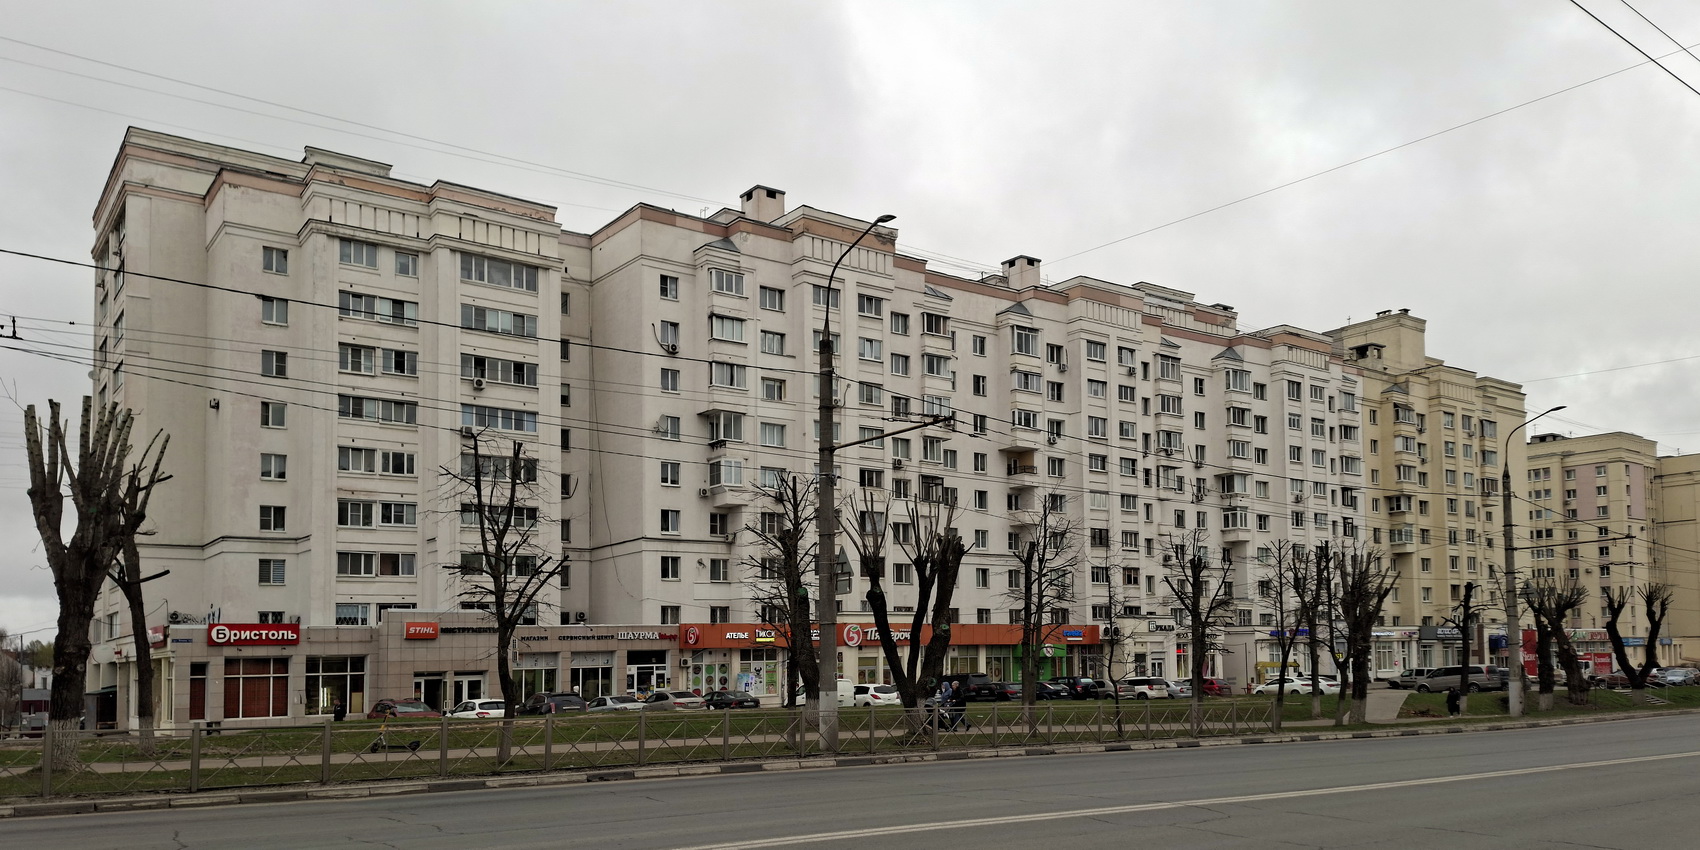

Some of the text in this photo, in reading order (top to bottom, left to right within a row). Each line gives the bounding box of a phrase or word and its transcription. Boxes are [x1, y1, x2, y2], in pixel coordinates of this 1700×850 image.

[408, 626, 435, 634] STIHL
[213, 627, 298, 643] Бристоль
[617, 631, 660, 640] ШАУРМА
[725, 632, 749, 640] АТЕЛЬЕ
